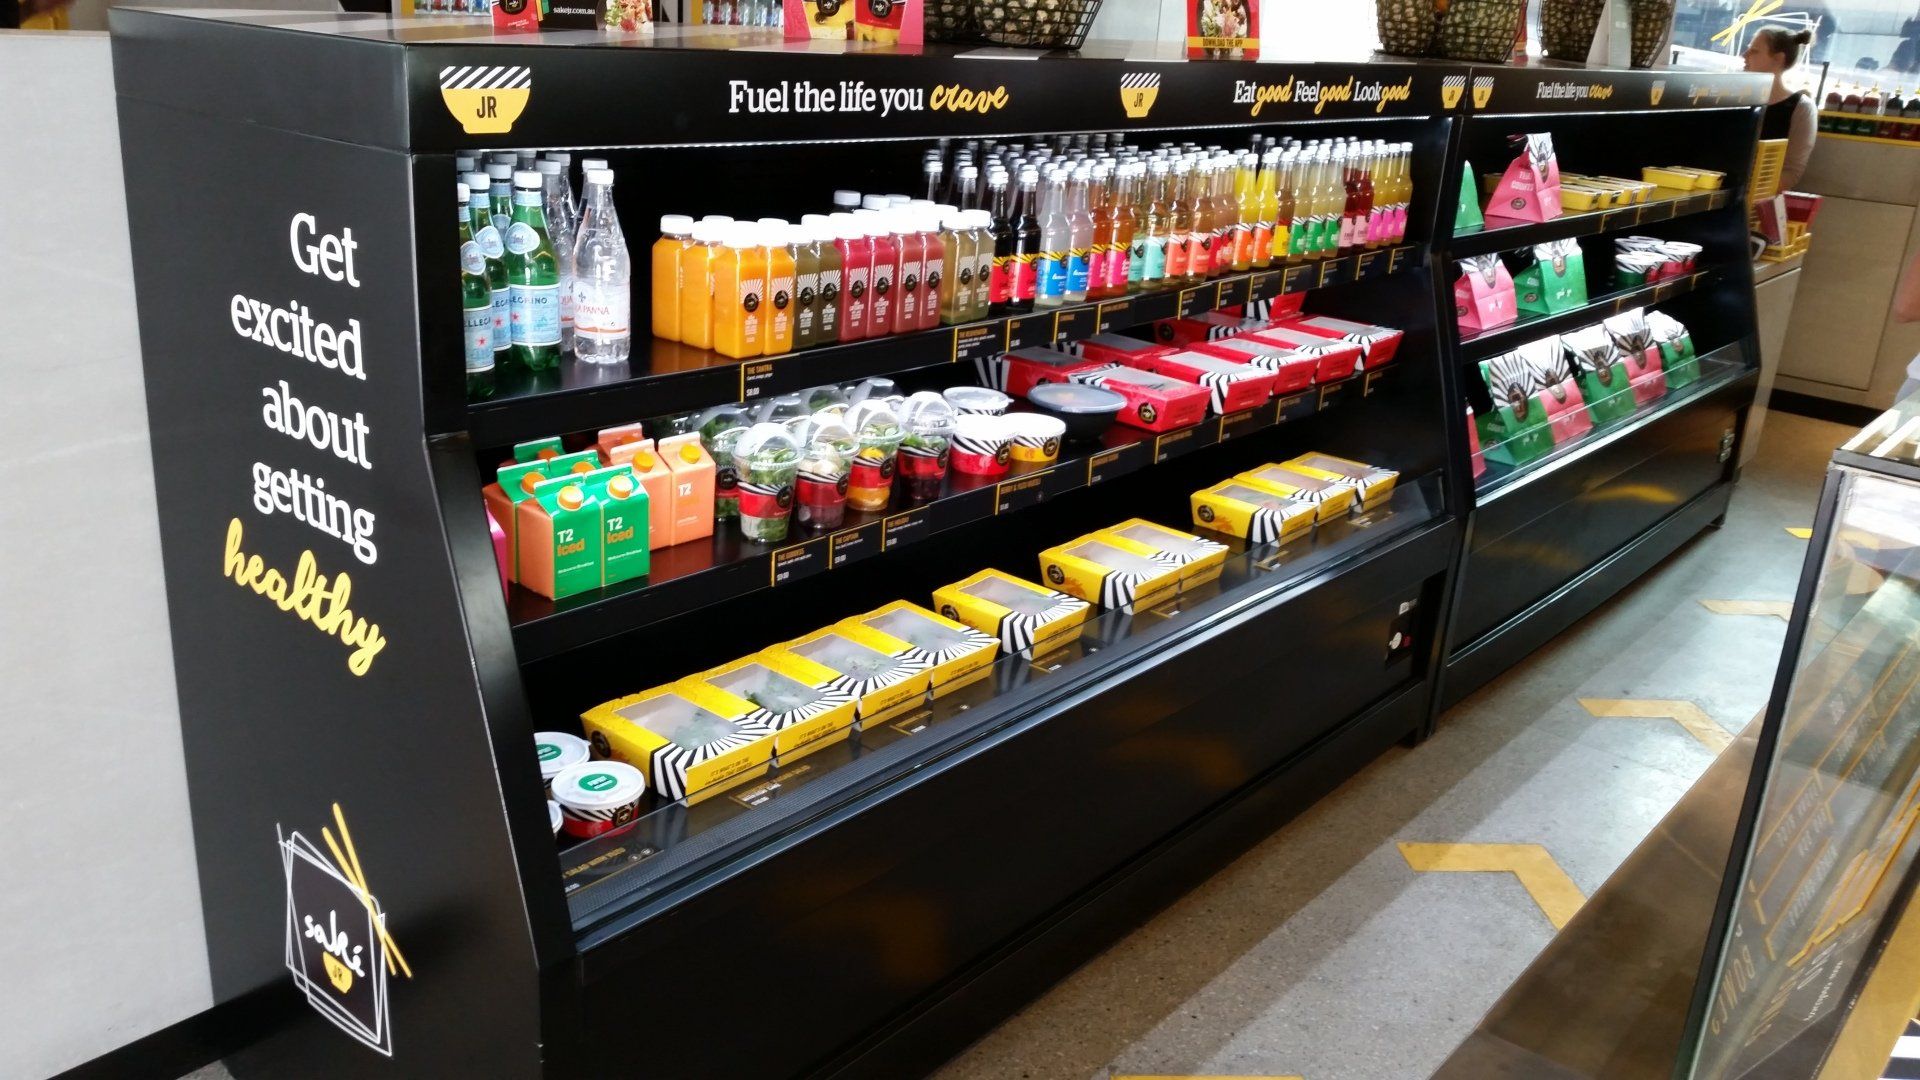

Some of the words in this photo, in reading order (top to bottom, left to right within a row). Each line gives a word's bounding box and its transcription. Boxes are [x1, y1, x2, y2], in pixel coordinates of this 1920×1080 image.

[552, 6, 596, 16] sakejr.com.au
[1202, 38, 1226, 47] DOWNLOAD
[1226, 38, 1234, 47] THE
[728, 80, 790, 113] Fuel
[793, 80, 836, 113] the
[838, 80, 877, 113] life
[880, 88, 924, 118] you
[929, 84, 1009, 114] crave
[1133, 93, 1144, 108] JR
[1233, 80, 1257, 103] Eat
[1250, 74, 1294, 117] good
[1293, 80, 1321, 103] Feel
[1314, 75, 1354, 115] good
[1352, 81, 1382, 102] Look
[1375, 75, 1412, 114] good
[1535, 81, 1554, 99] Fuel
[1553, 82, 1566, 99] the
[1564, 82, 1576, 99] life
[1574, 86, 1590, 101] you
[475, 95, 498, 120] JR
[290, 212, 360, 288] Get
[583, 305, 610, 315] PANNA
[231, 293, 367, 381] excited
[262, 380, 373, 470] about
[678, 483, 692, 497] T2
[252, 462, 378, 565] getting
[606, 516, 623, 532] T2
[557, 528, 574, 544] T2
[607, 526, 634, 544] Iced
[557, 537, 585, 557] Iced
[224, 517, 387, 677] healthy
[332, 964, 344, 984] JR
